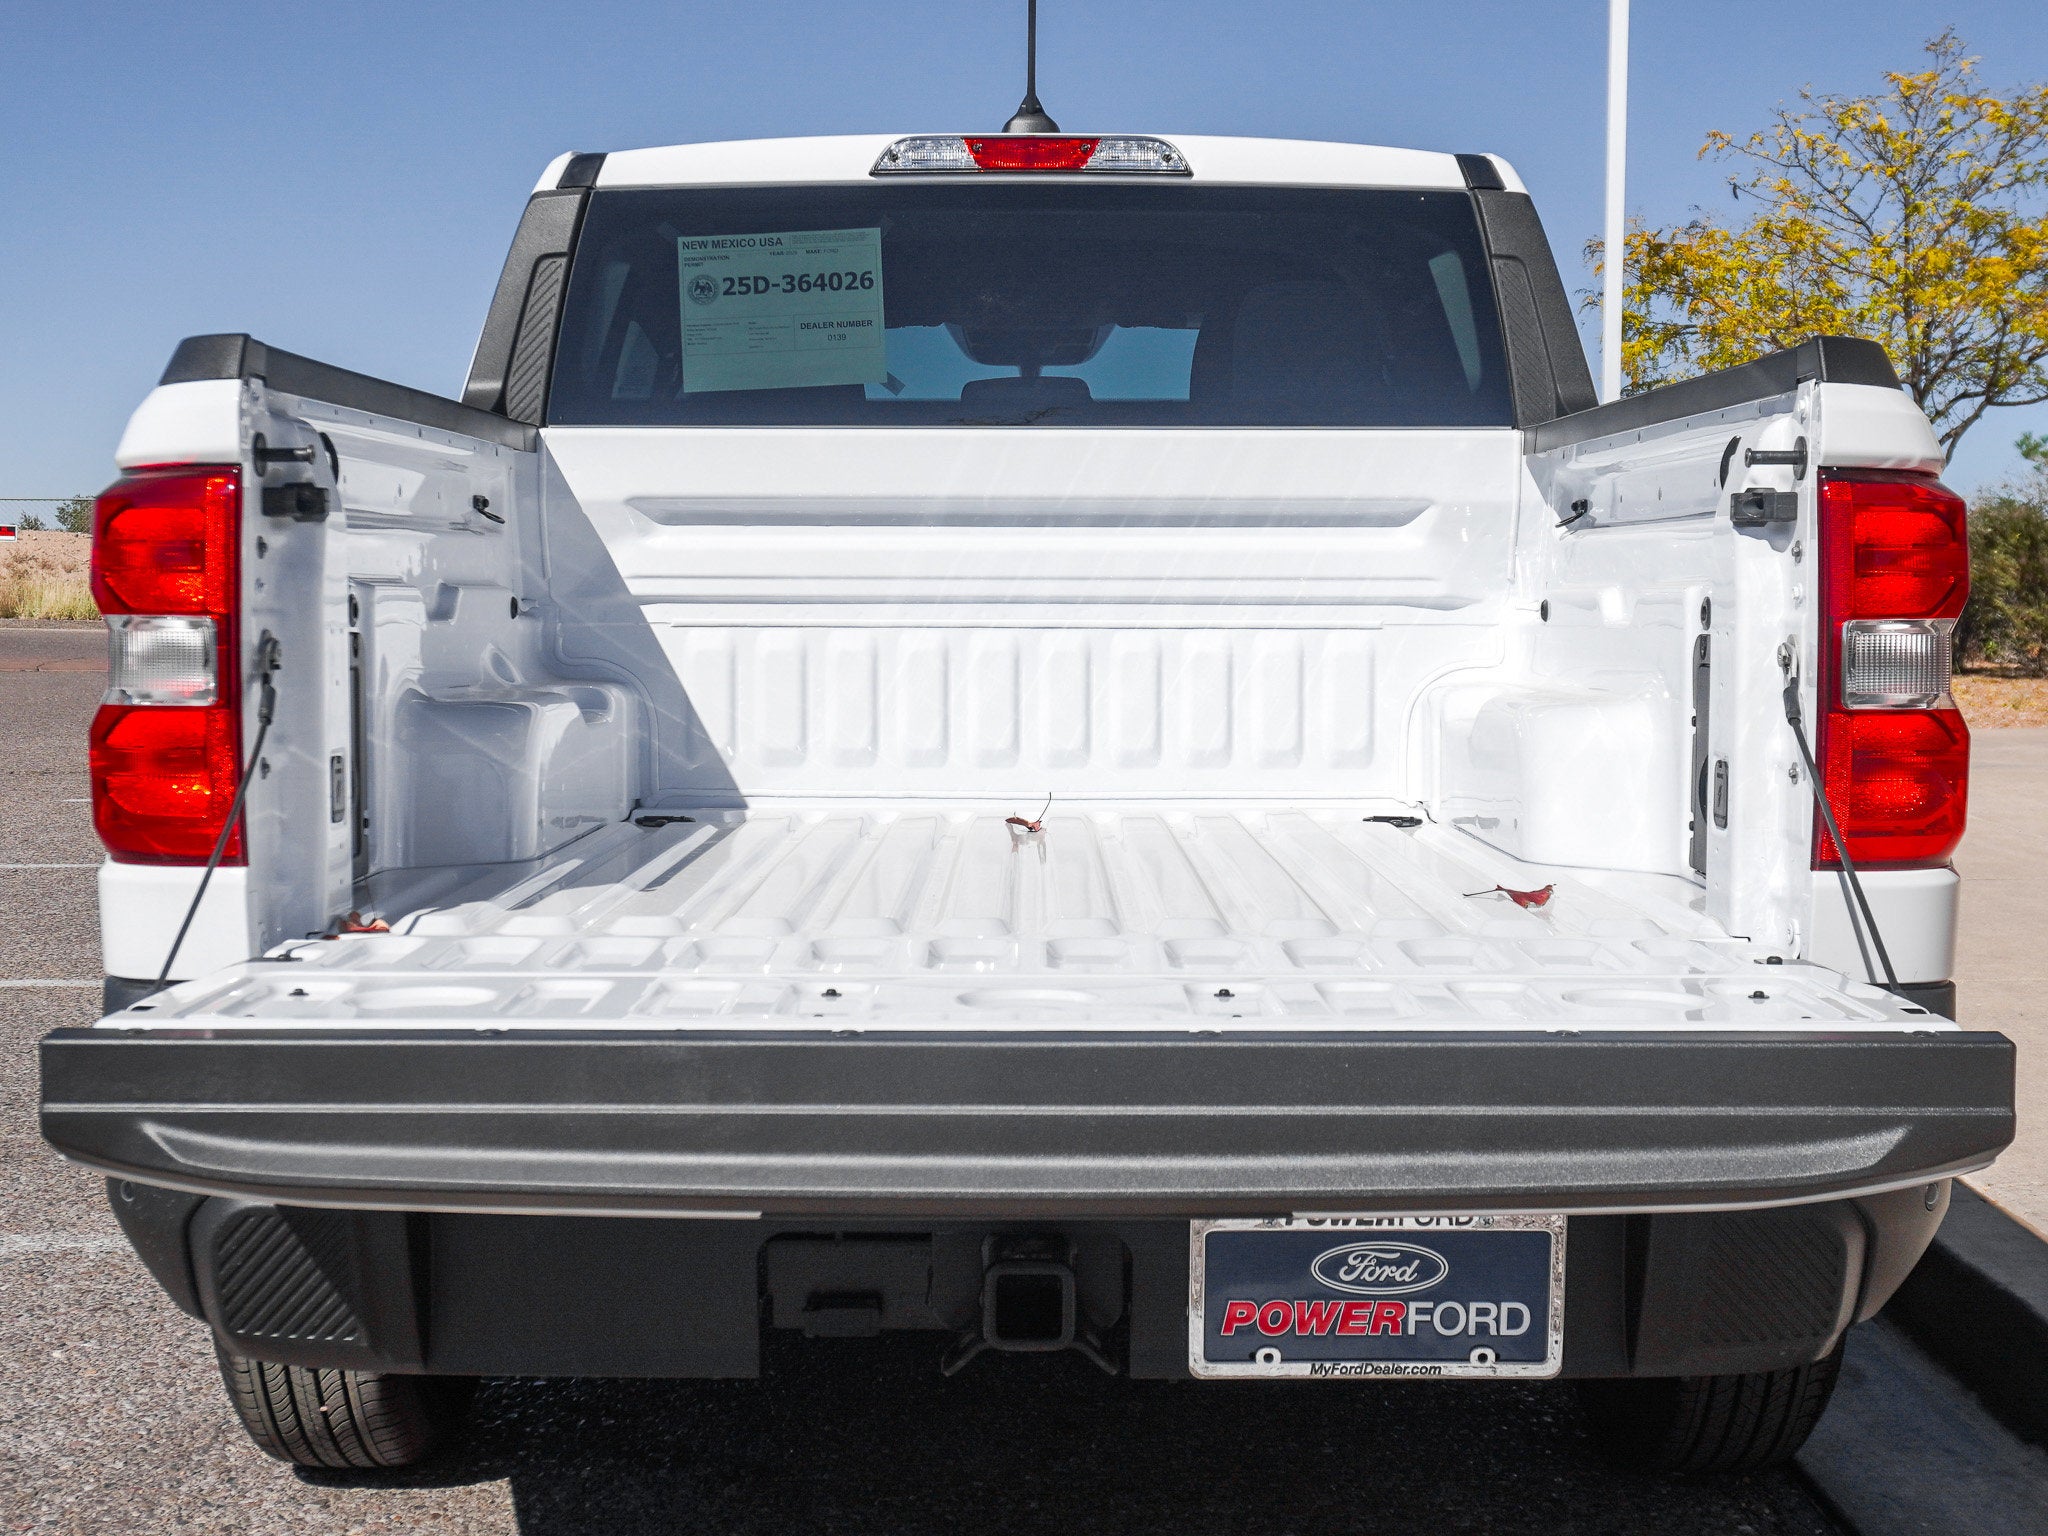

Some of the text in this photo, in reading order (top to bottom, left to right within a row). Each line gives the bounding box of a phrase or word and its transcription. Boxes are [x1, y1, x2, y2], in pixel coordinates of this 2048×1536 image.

[682, 240, 708, 250] NEW
[711, 238, 756, 249] MEXICO
[759, 237, 783, 247] USA
[722, 270, 874, 296] 25D-364026
[800, 319, 873, 330] DEALER NUMBER
[827, 333, 847, 341] 0139
[1338, 1251, 1420, 1284] Ford
[1309, 1362, 1443, 1378] MyFordDealer.com
